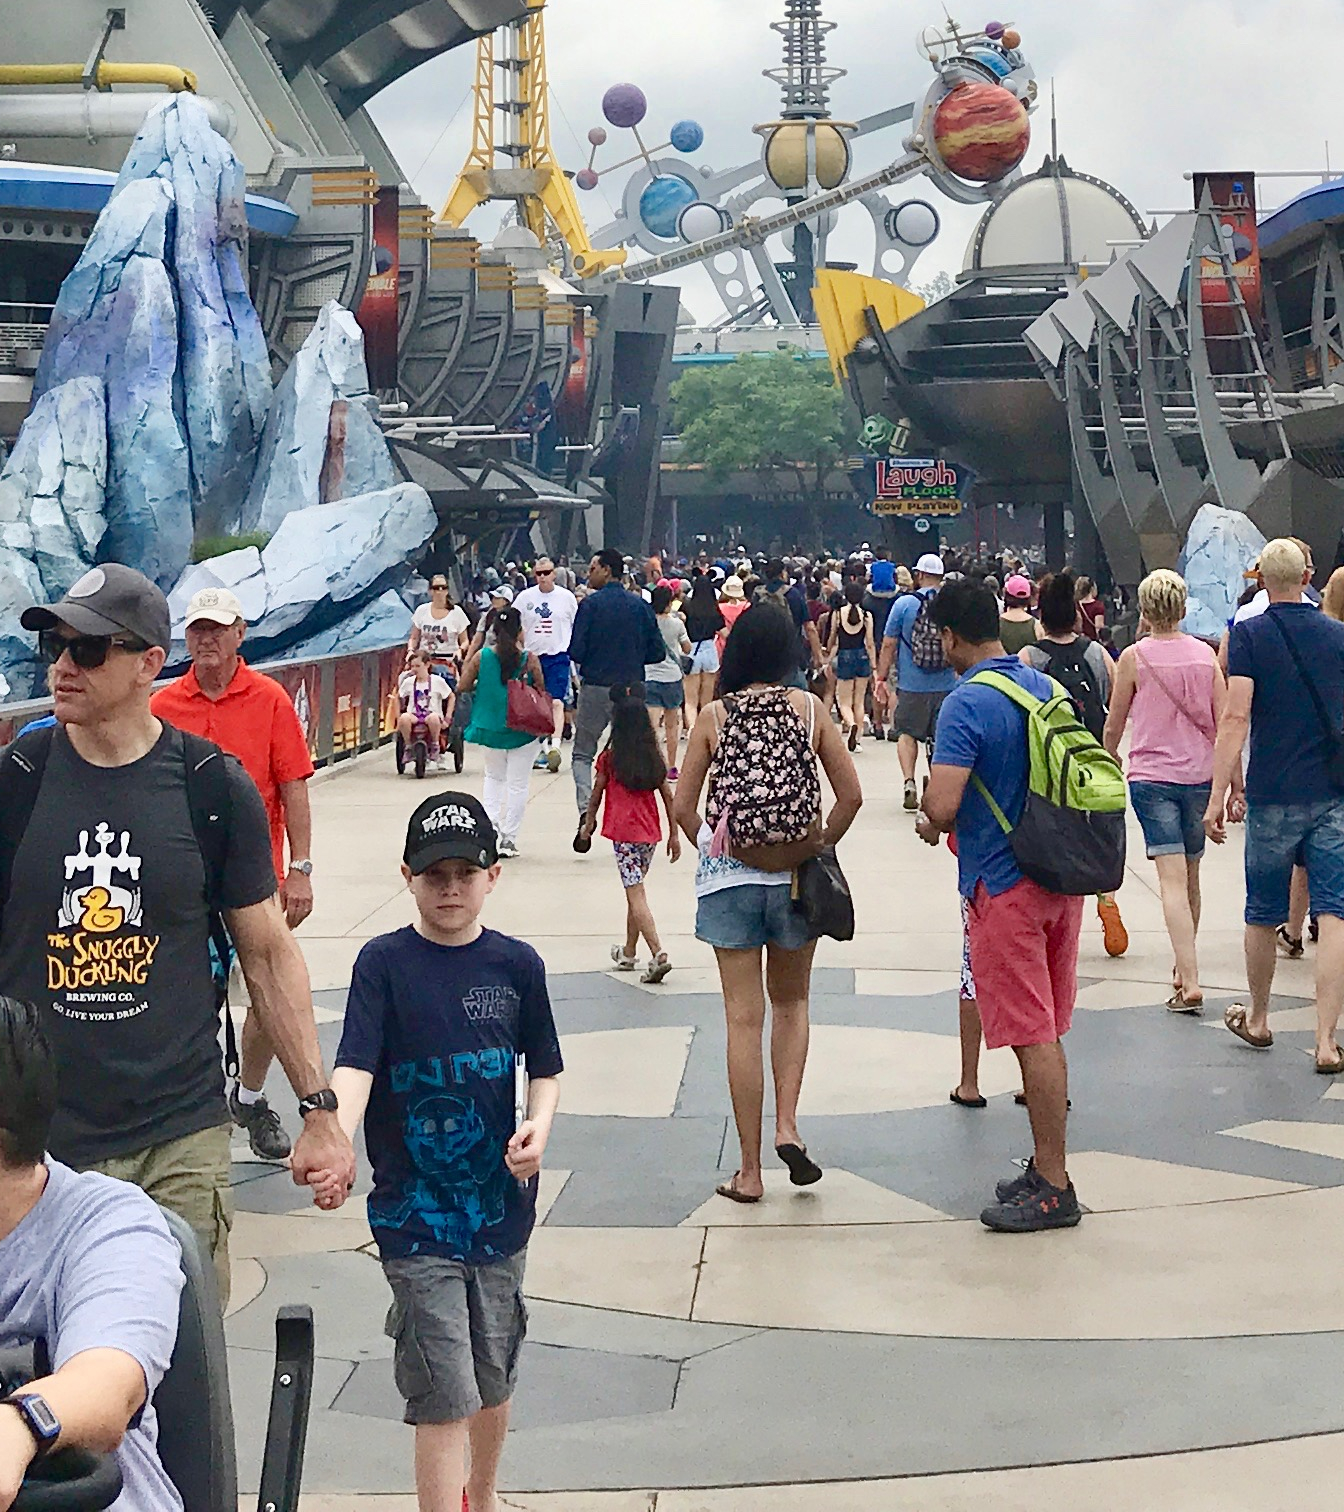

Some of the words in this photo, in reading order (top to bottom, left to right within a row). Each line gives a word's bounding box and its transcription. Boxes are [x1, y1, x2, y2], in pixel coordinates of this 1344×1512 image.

[876, 460, 957, 496] Laugh
[875, 502, 902, 511] NOW
[429, 804, 472, 819] STAR
[421, 815, 476, 833] WARS
[66, 992, 116, 1002] BREWING
[463, 986, 520, 1003] STAR
[65, 1008, 87, 1020] LIVE
[88, 1012, 115, 1021] YOUR
[116, 1001, 149, 1020] DREAM
